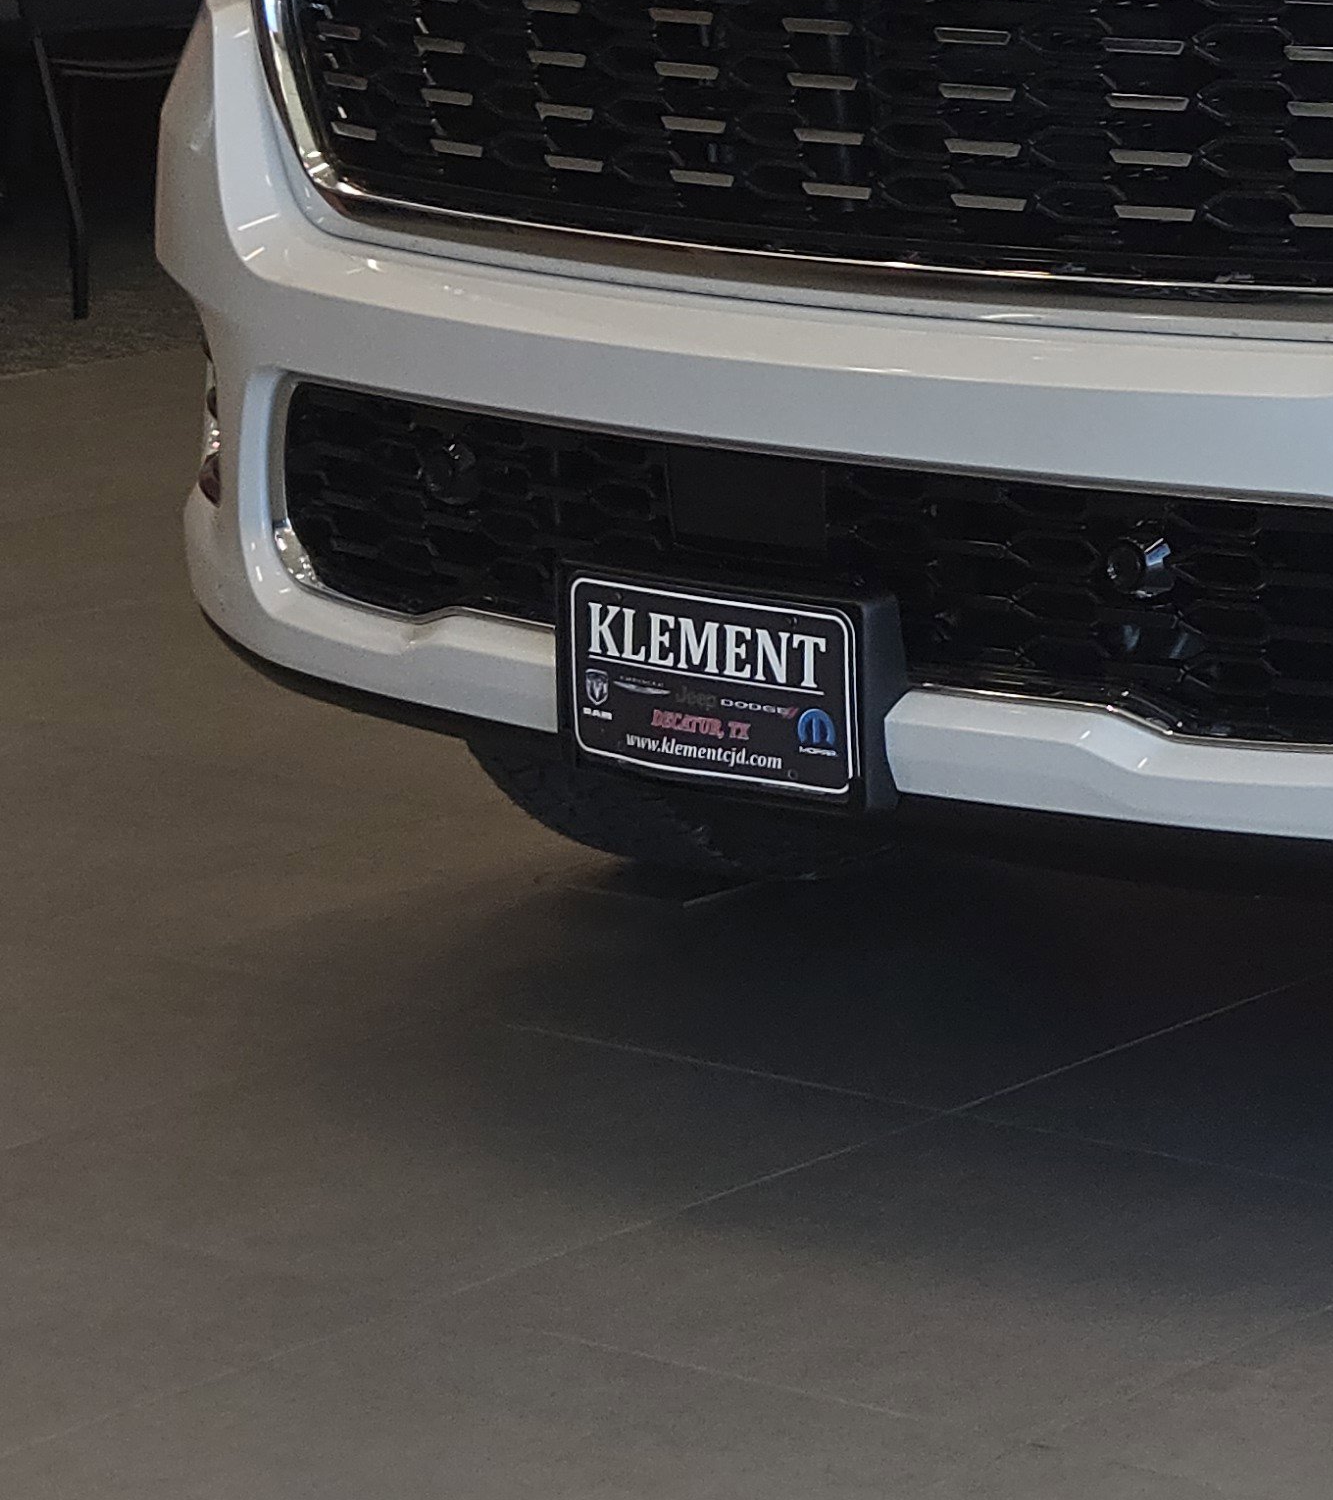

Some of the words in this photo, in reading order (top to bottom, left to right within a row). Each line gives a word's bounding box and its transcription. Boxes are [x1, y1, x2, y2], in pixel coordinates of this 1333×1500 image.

[587, 602, 827, 689] KLEMENT
[720, 698, 788, 715] DODGE
[651, 709, 725, 739] DECATUR,
[728, 721, 751, 741] TX
[626, 733, 783, 770] www.klementcjd.com
